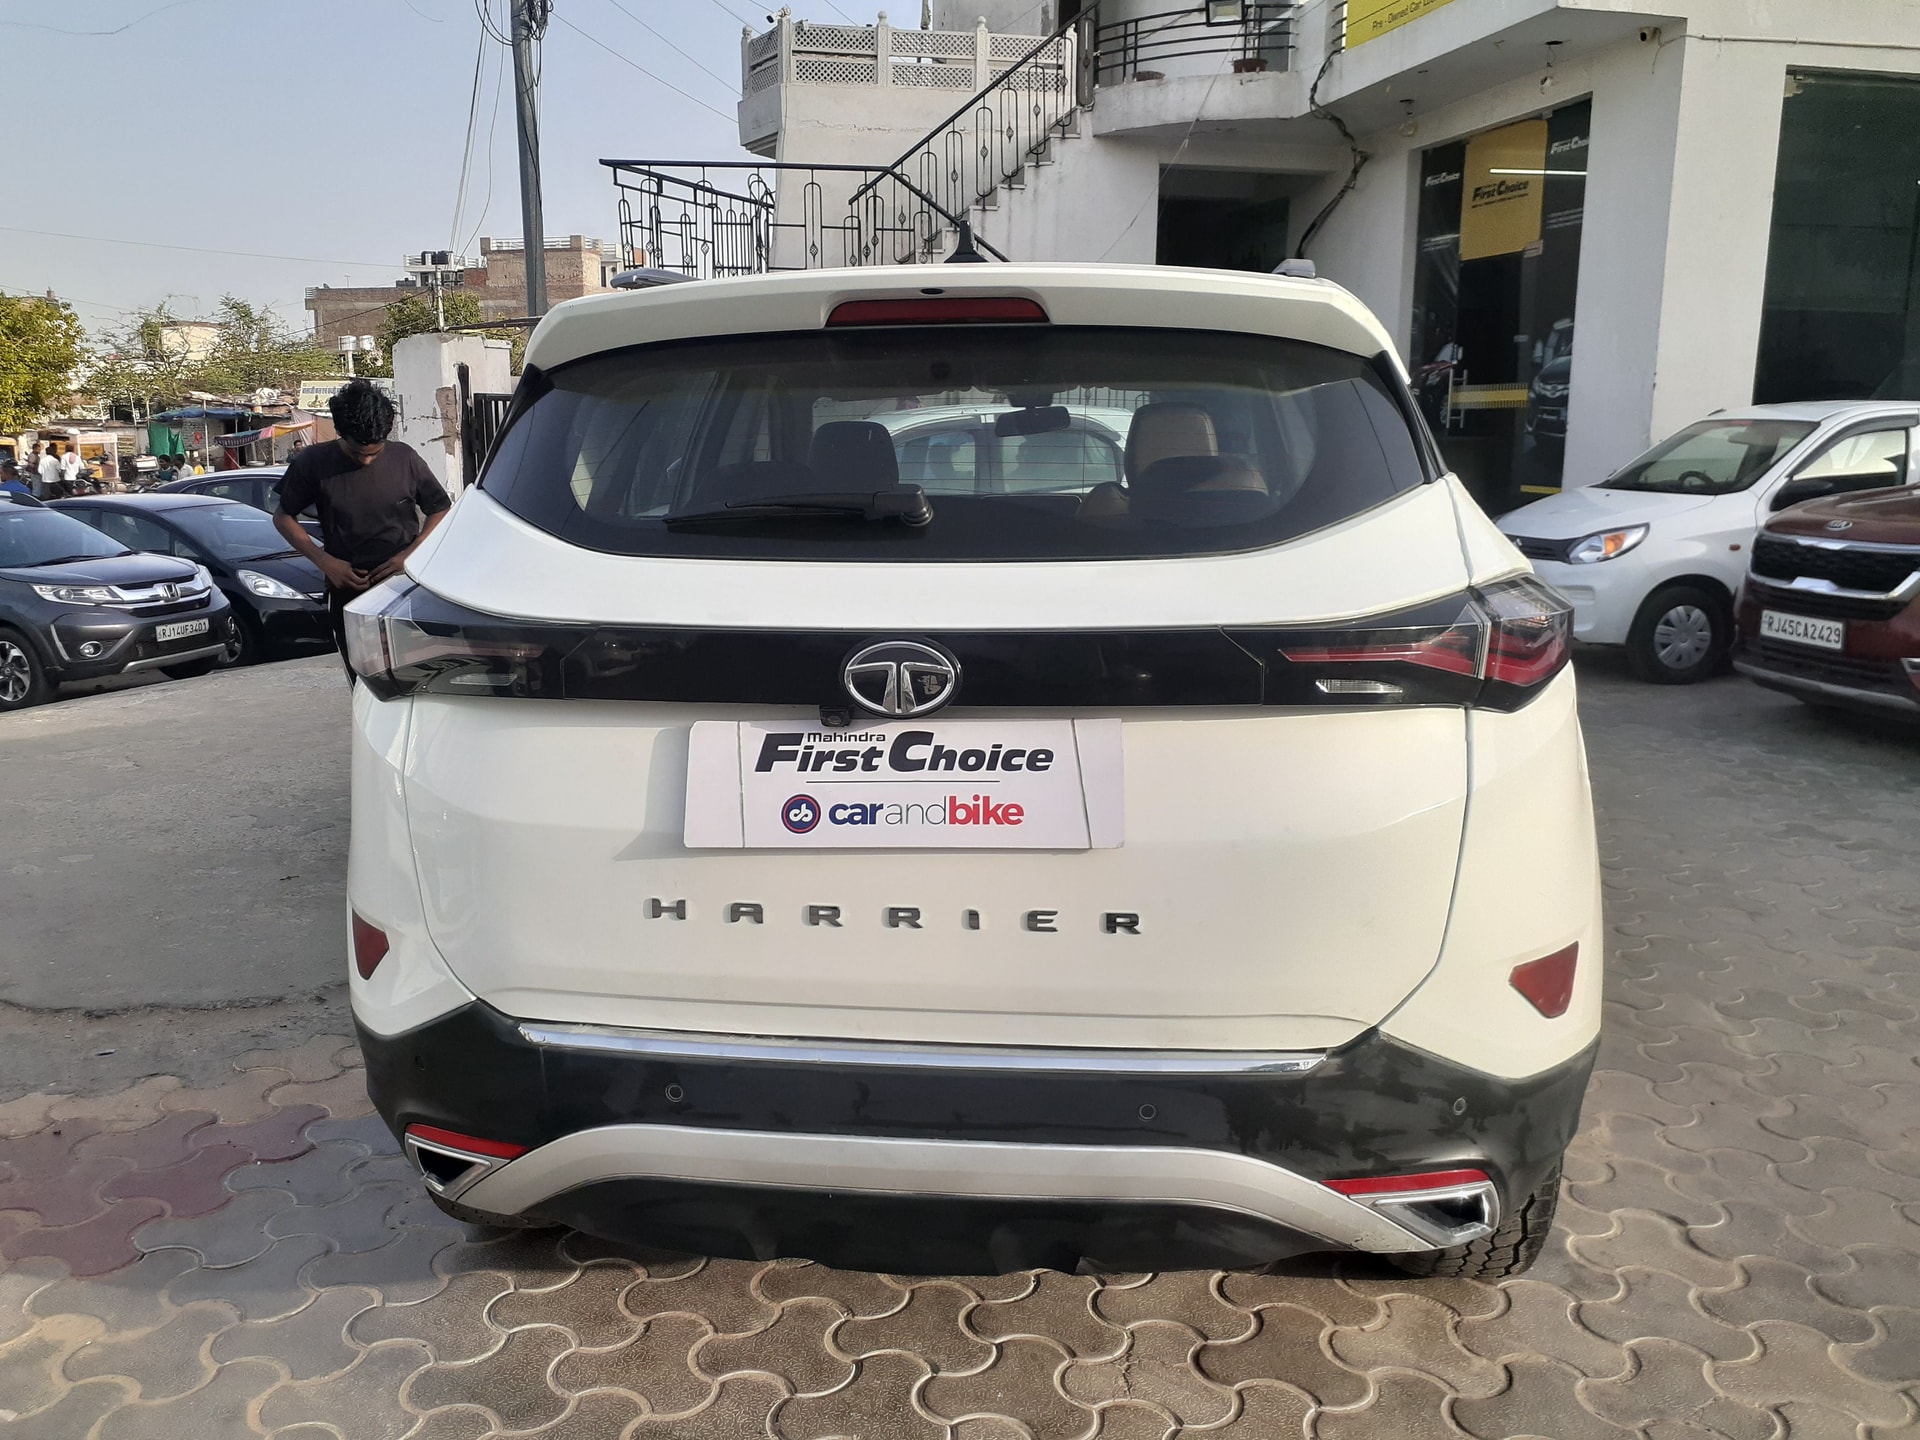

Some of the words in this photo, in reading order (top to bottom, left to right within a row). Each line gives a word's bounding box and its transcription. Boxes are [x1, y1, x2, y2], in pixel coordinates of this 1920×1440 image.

[1409, 1, 1423, 13] Car
[1550, 141, 1571, 154] First
[1472, 186, 1496, 202] First
[1496, 180, 1529, 196] Choice
[1767, 615, 1841, 644] RJ45CA2429
[807, 732, 886, 743] Mahindra
[754, 732, 885, 773] First
[888, 730, 1055, 773] Choice
[828, 794, 1025, 826] carandbike
[648, 897, 1142, 935] HARRIER
